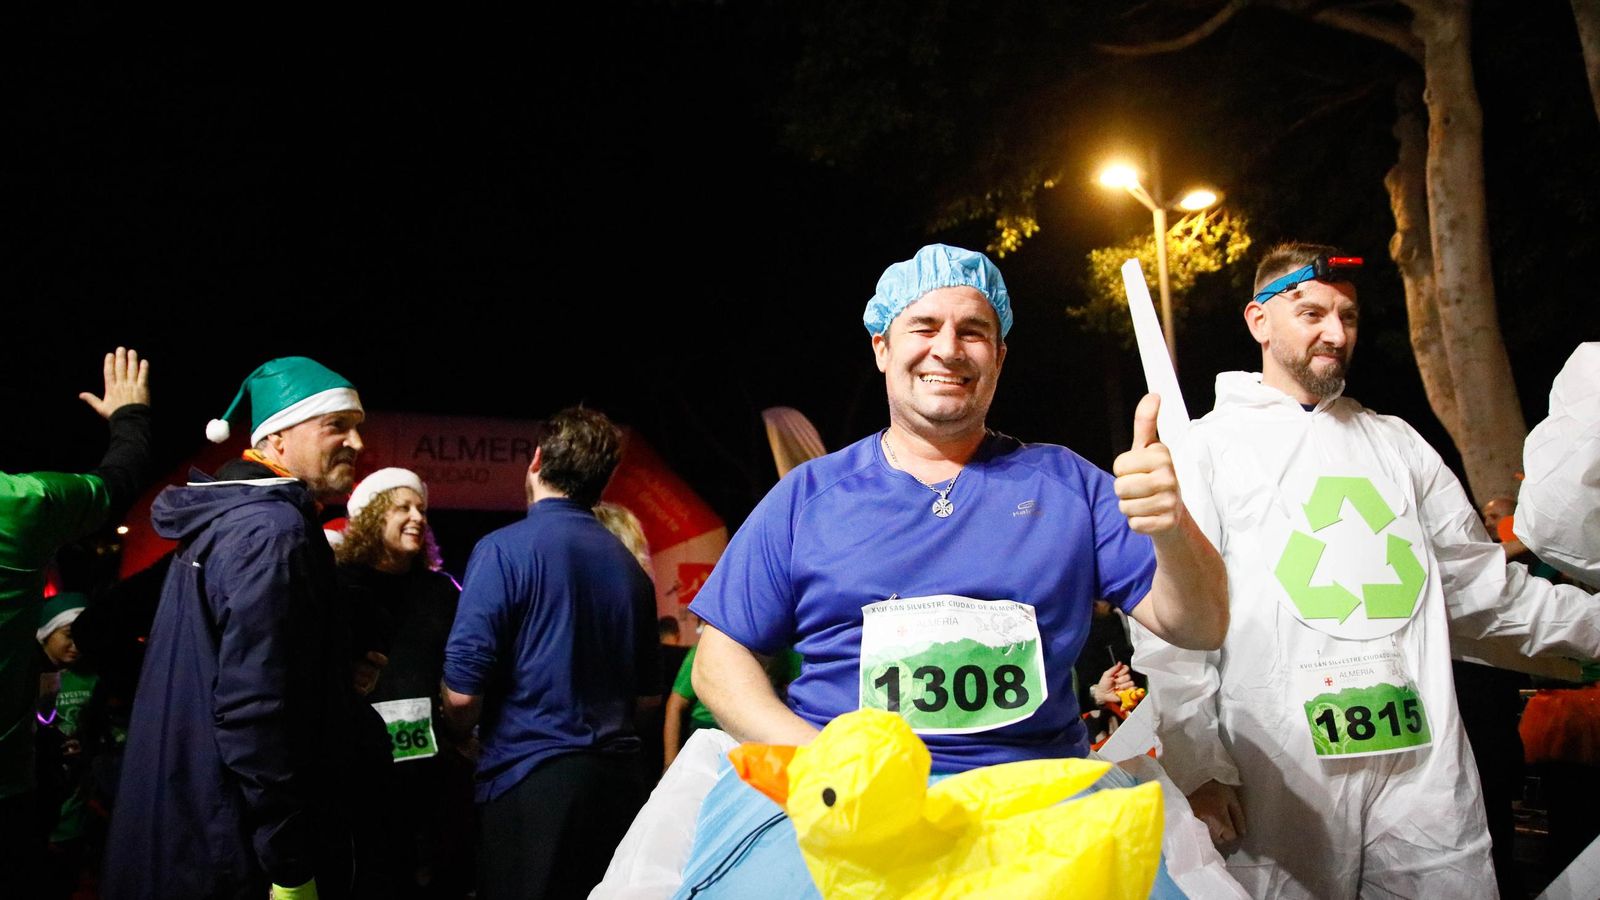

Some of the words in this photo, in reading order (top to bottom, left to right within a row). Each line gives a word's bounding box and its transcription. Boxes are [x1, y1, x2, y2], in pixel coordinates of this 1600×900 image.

[413, 434, 536, 462] ALMER
[907, 601, 945, 611] SILVESTRE
[948, 600, 976, 610] CIUDAD
[874, 664, 1030, 714] 1308
[1315, 698, 1423, 743] 1815
